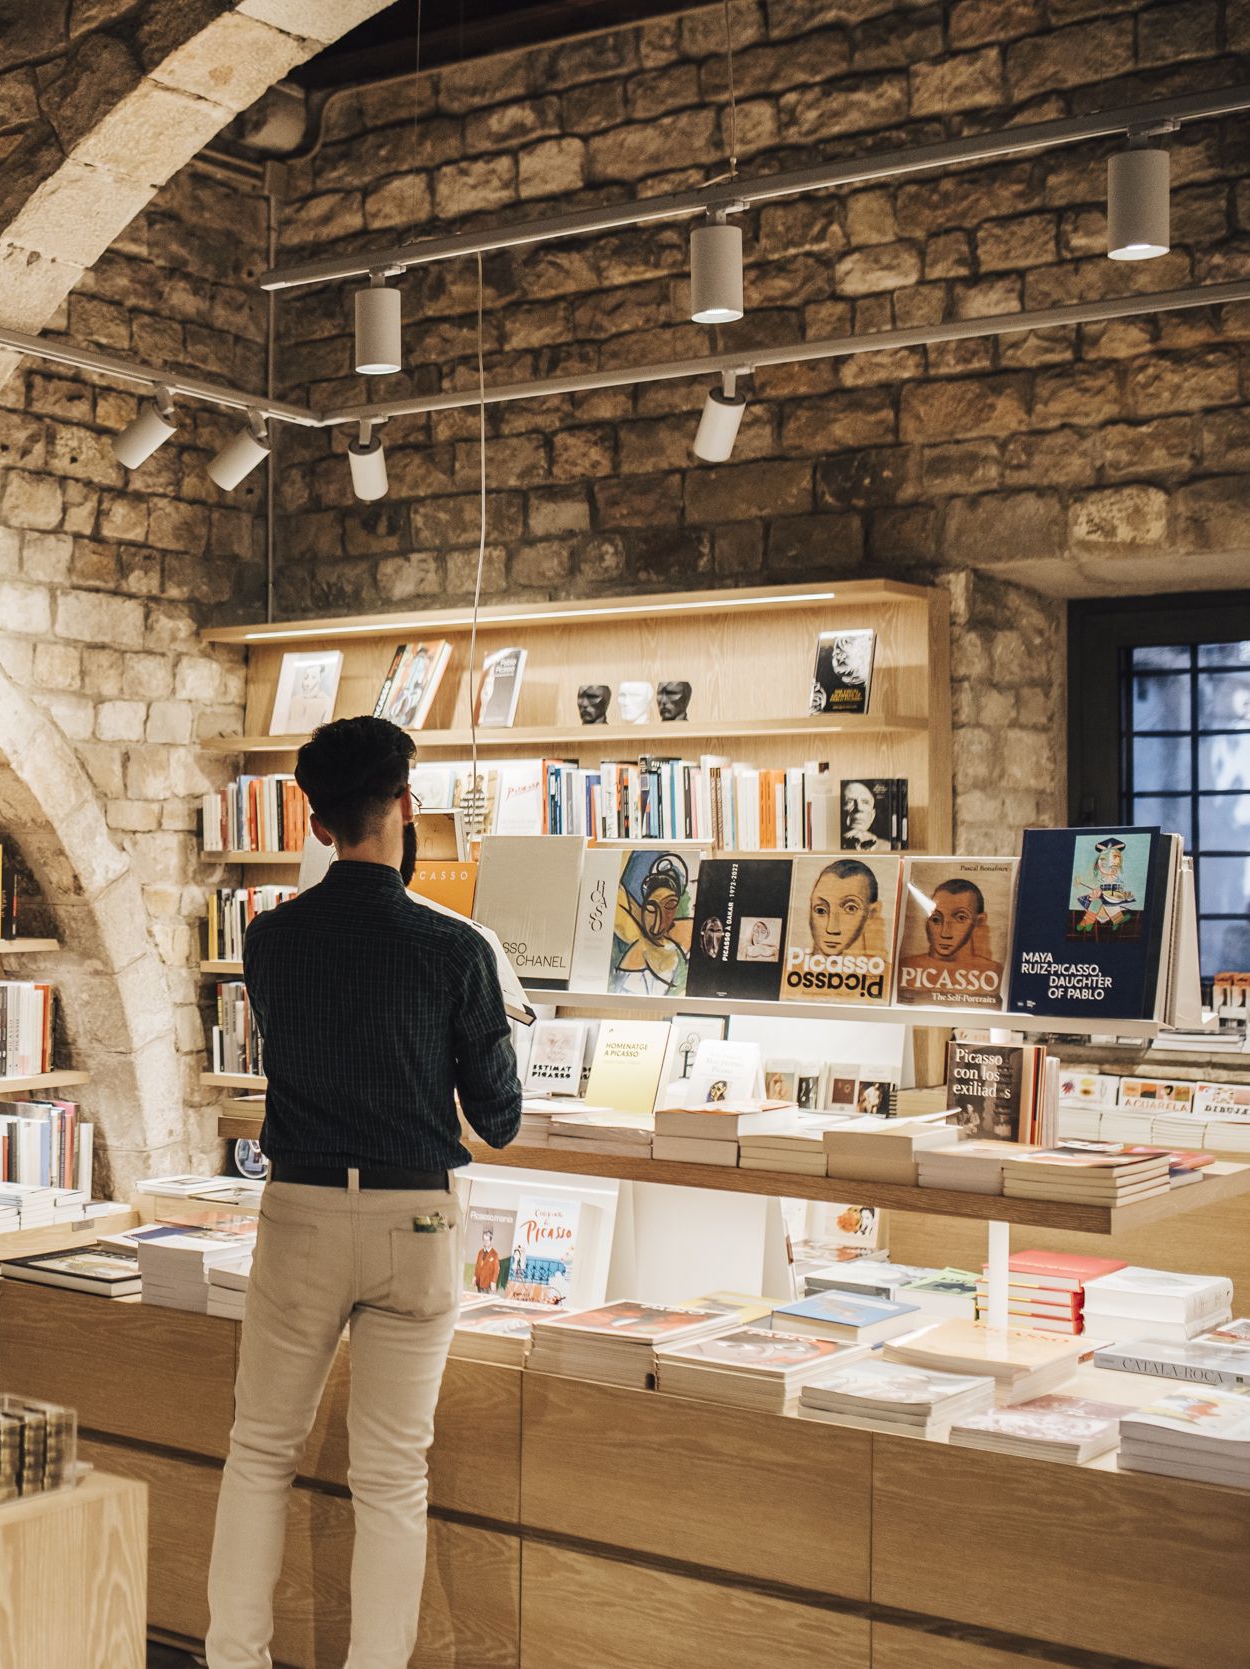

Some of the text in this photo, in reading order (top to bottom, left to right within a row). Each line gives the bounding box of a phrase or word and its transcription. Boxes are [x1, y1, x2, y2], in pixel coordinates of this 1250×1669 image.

[411, 871, 468, 881] ICASSO
[729, 863, 739, 897] 1972-2022
[726, 902, 735, 926] DAKAR
[502, 942, 527, 955] SSO
[722, 931, 732, 962] PICASSO
[515, 954, 567, 969] CHANEL
[787, 947, 885, 974] Picasso
[1022, 952, 1054, 963] MAYA
[1021, 963, 1102, 977] RUIZ-PICASSO,
[787, 971, 884, 999] Picasso
[901, 967, 998, 992] PICASSO
[1049, 976, 1113, 988] DAUGHTER
[932, 992, 996, 1004] The Self-Portraits
[1048, 988, 1105, 1000] OF PABLO
[605, 1043, 648, 1051] HOMENATGE
[610, 1050, 639, 1058] PICASSO
[955, 1048, 1003, 1066] Picasso
[533, 1064, 572, 1072] ESTIMAT
[953, 1065, 1001, 1082] con los
[531, 1071, 571, 1079] PICASSO
